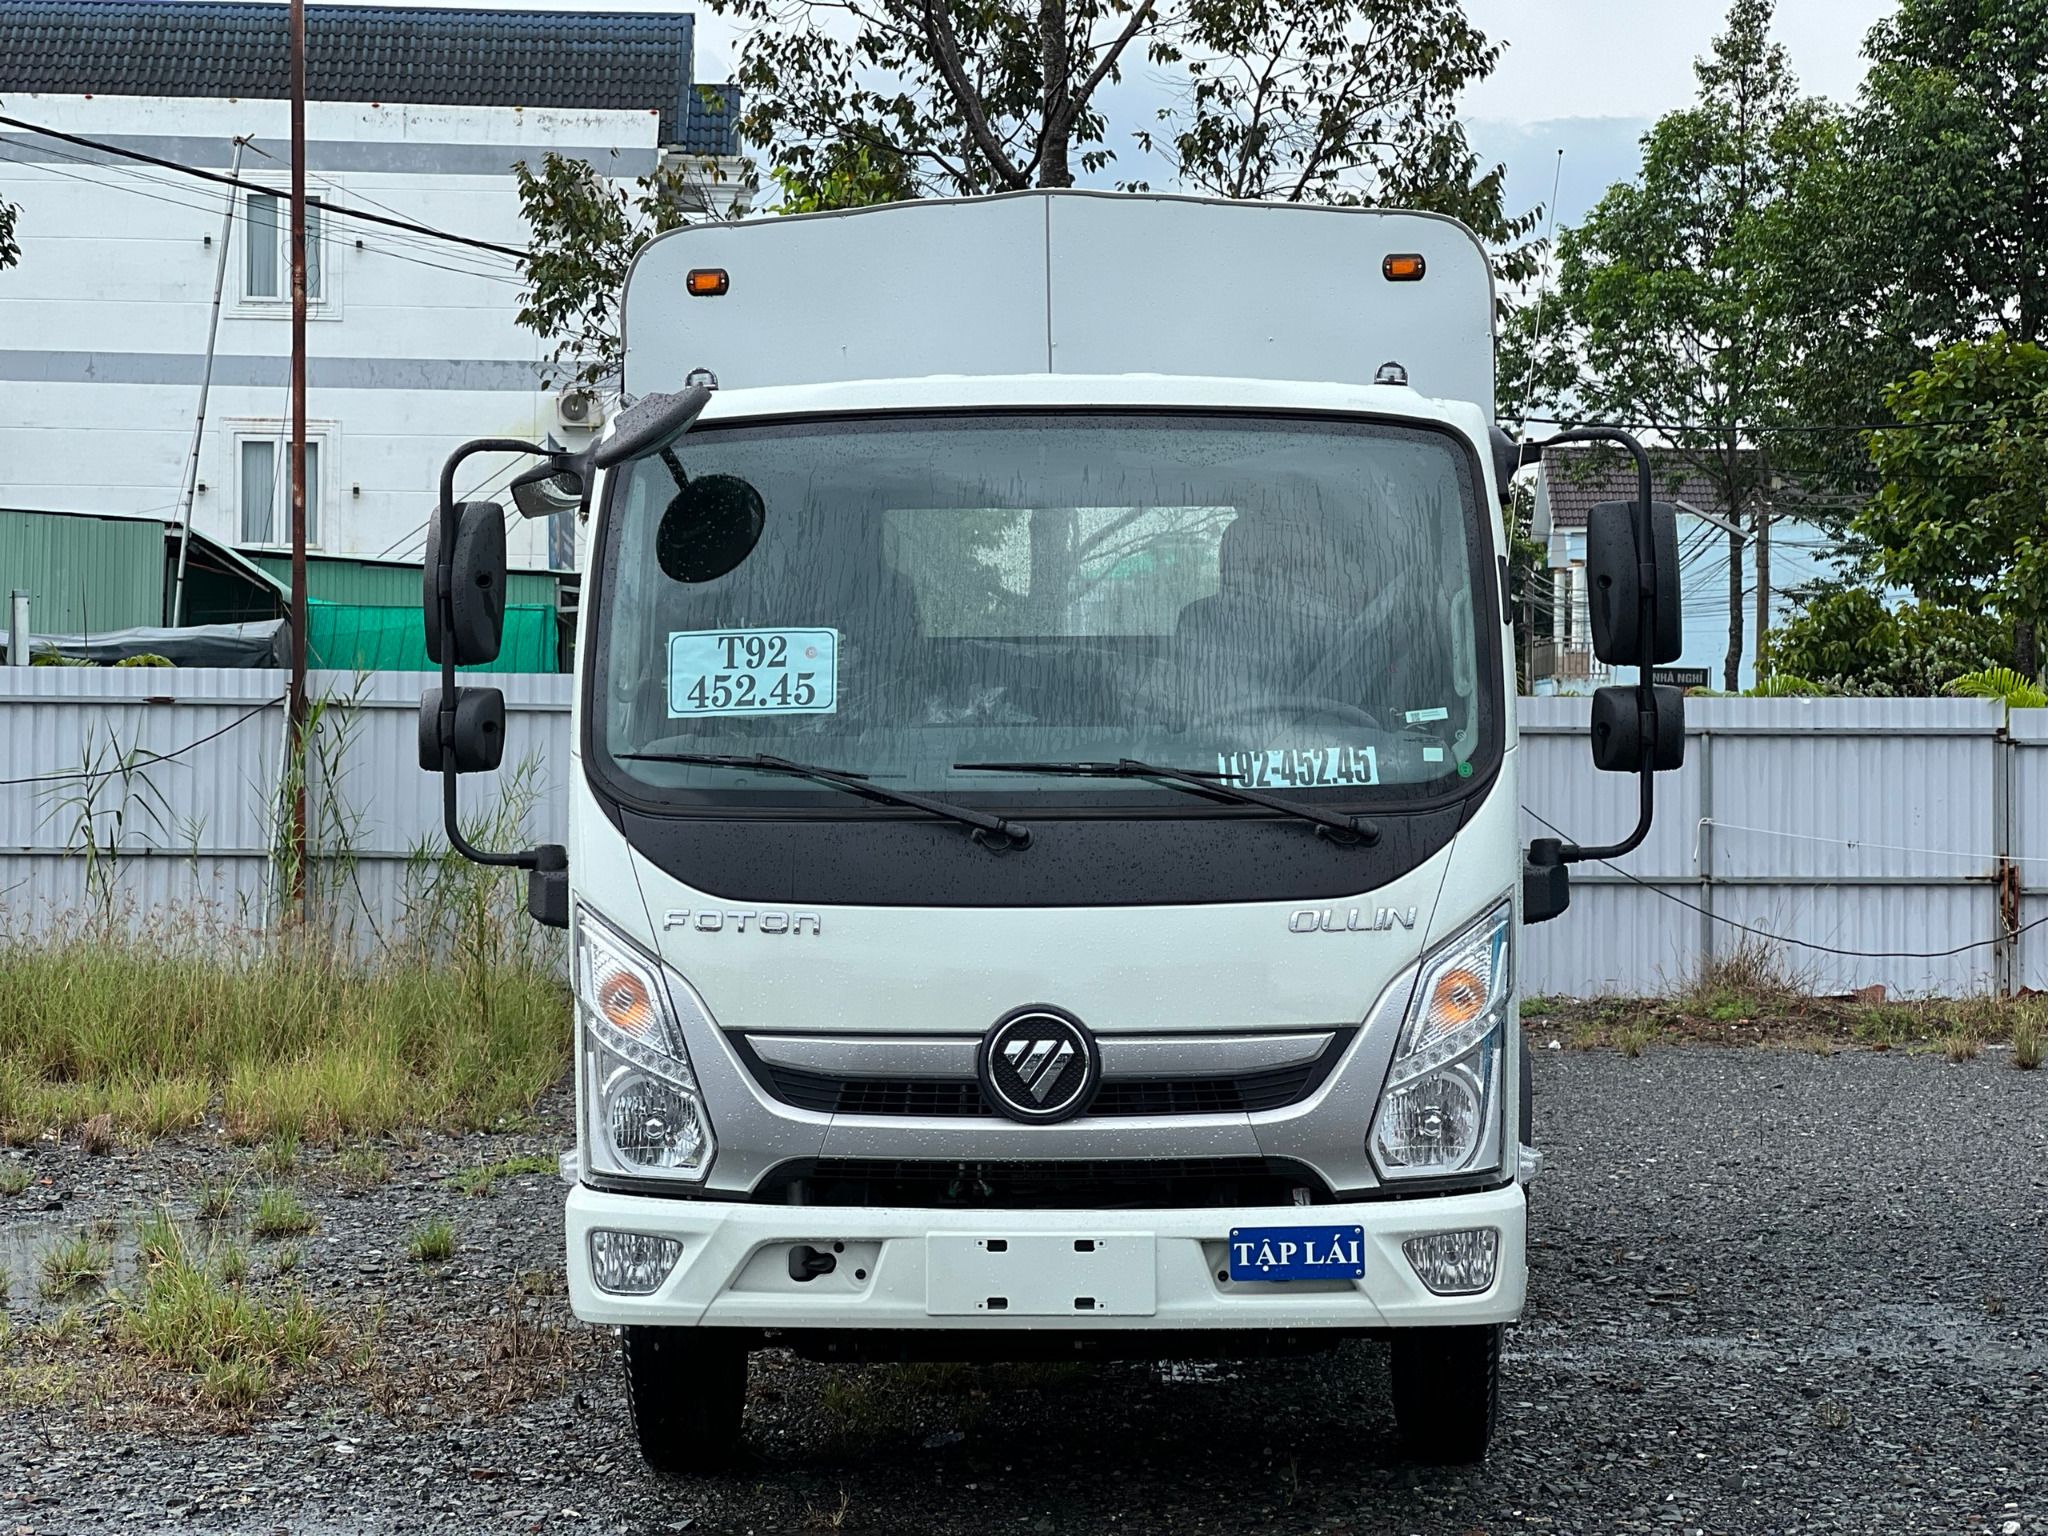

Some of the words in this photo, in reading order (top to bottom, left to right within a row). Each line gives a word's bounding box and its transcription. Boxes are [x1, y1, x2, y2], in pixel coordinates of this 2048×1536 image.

[717, 636, 788, 670] T92
[687, 672, 816, 709] 452.45
[1220, 748, 1373, 787] T92-452.45
[663, 908, 821, 936] FOTON
[1288, 906, 1417, 933] OLLIN
[1233, 1238, 1297, 1272] TẬP
[1303, 1233, 1360, 1264] LÁI
